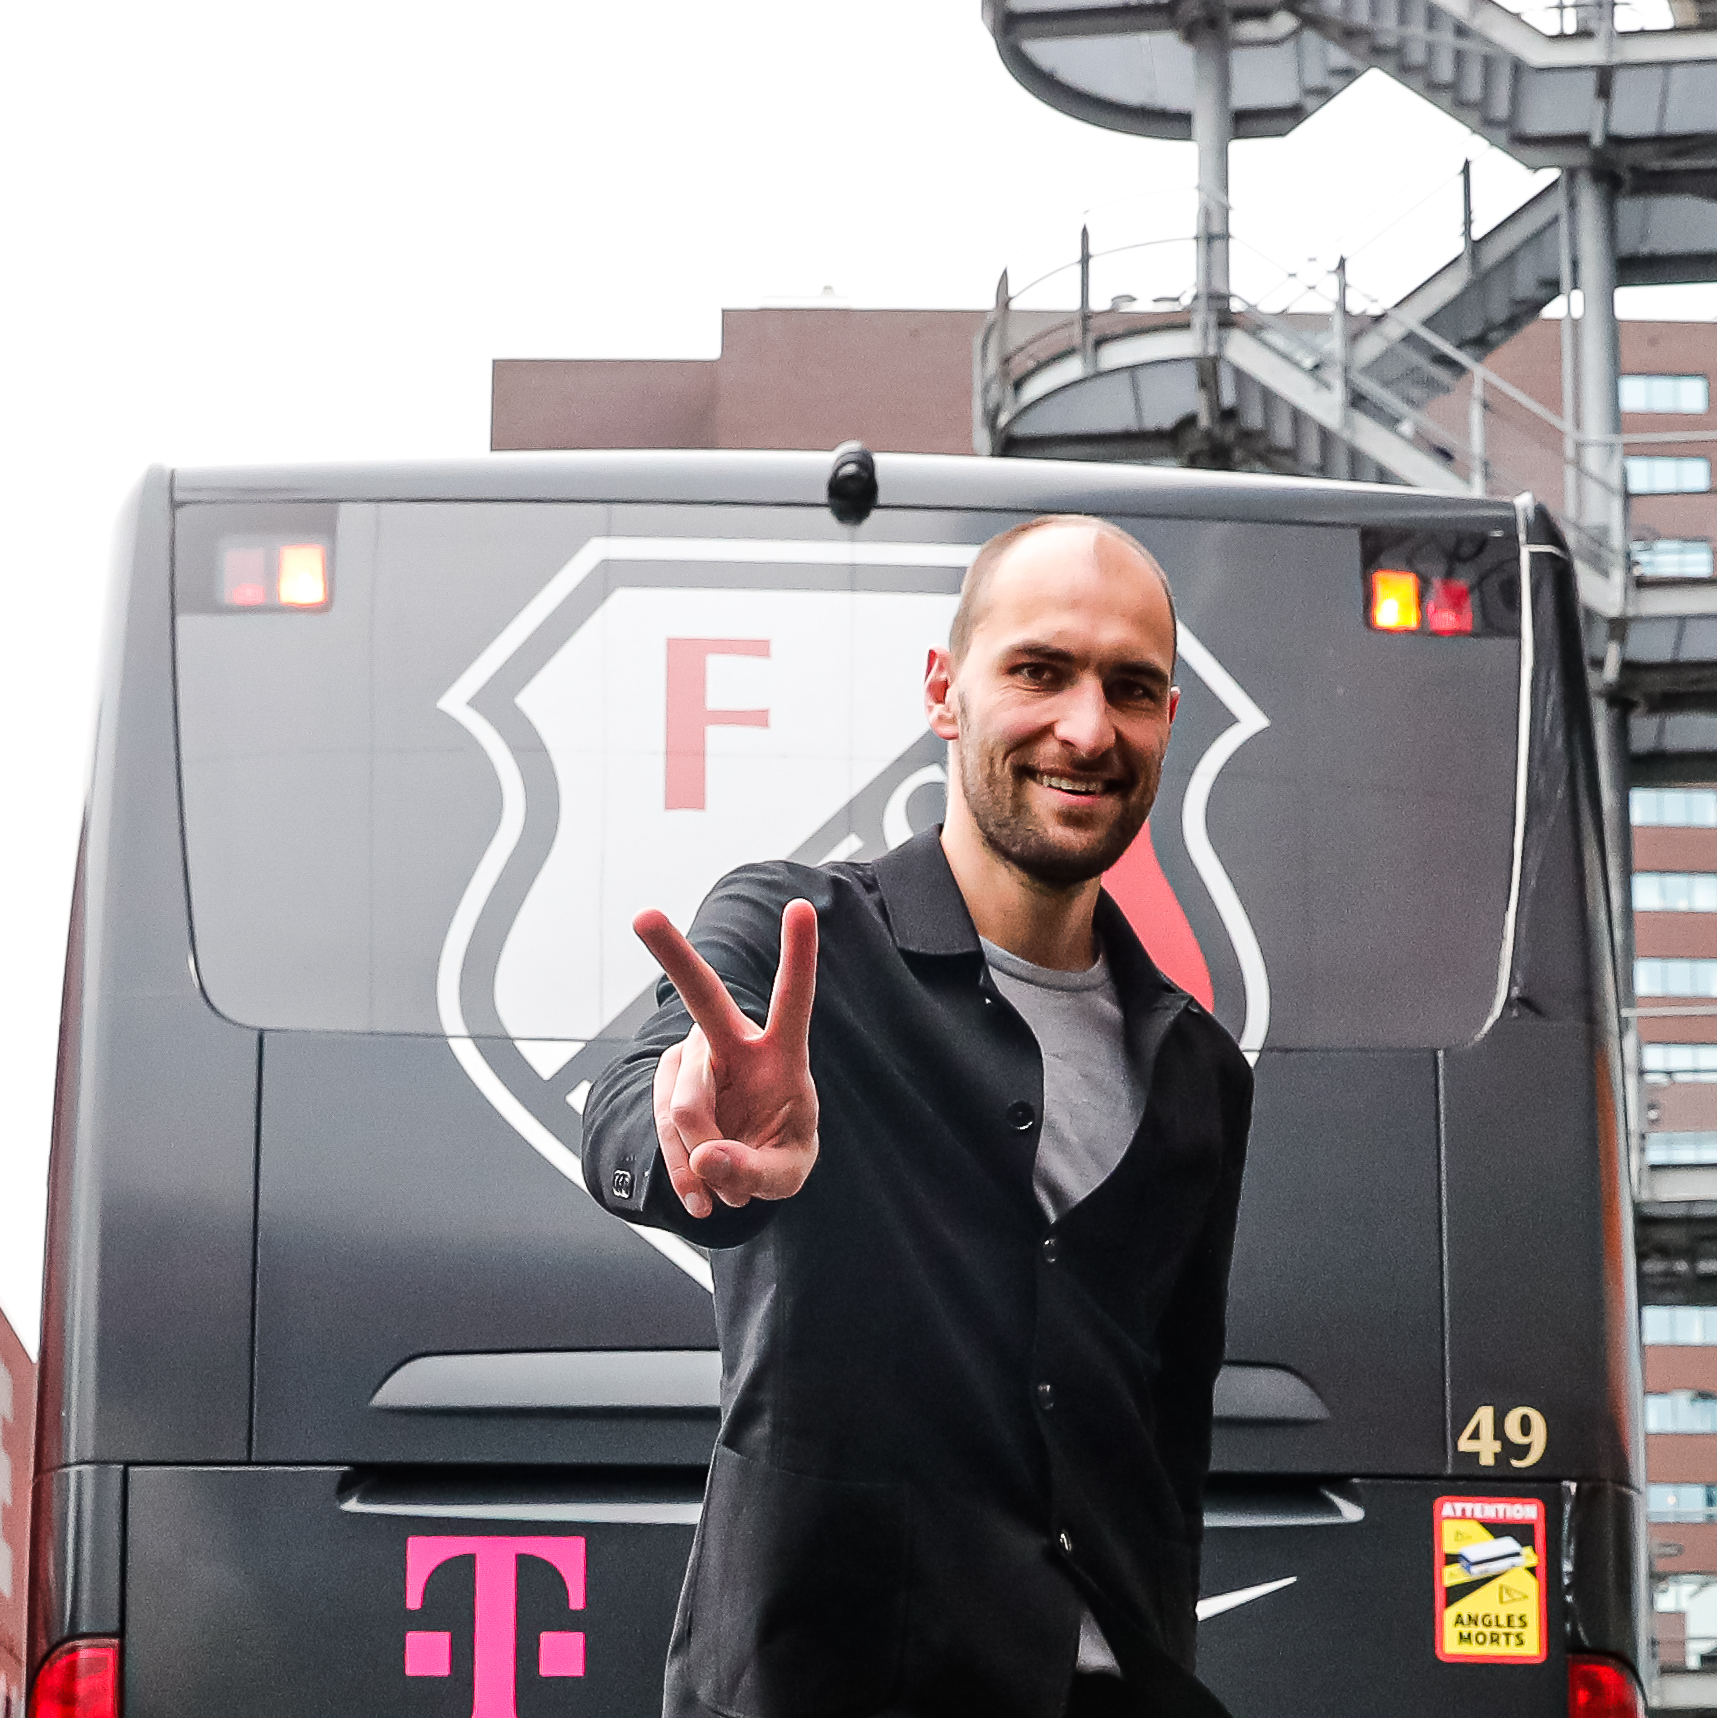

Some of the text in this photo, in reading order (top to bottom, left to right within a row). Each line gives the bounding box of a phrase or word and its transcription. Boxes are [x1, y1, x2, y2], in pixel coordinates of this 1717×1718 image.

[666, 638, 771, 811] F
[1457, 1405, 1547, 1468] 49
[1441, 1502, 1538, 1520] ATTENTION
[1454, 1613, 1528, 1629] ANGLES
[1457, 1631, 1525, 1647] MORTS
